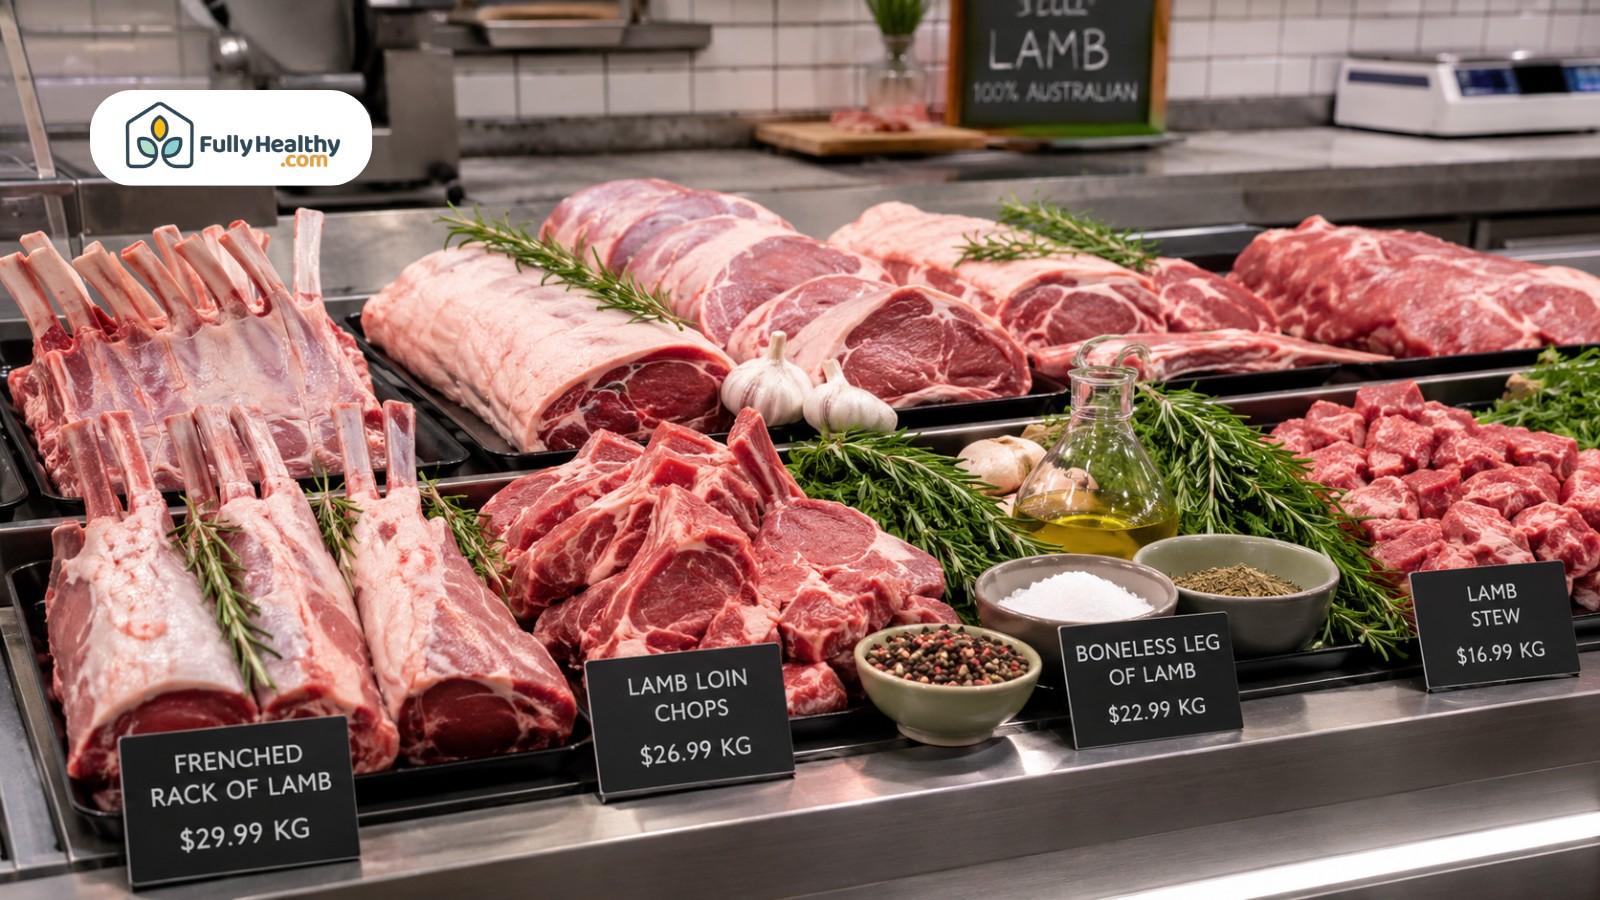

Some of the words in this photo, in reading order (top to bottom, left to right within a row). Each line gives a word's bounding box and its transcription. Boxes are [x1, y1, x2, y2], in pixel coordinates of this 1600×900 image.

[989, 28, 1109, 71] LAMB
[973, 82, 1018, 103] 100%
[1028, 81, 1138, 101] AUSTRALIAN
[1467, 583, 1517, 601] LAMB
[1472, 608, 1519, 627] STEW
[1076, 638, 1176, 662] BONELESS
[1184, 634, 1220, 652] LEG
[1457, 644, 1512, 666] $16.99
[1520, 641, 1545, 658] KG
[628, 674, 687, 695] LAMB
[696, 668, 747, 690] LOIN
[1109, 668, 1135, 685] OF
[1143, 663, 1196, 682] LAMB
[655, 699, 728, 722] CHOPS
[1109, 701, 1170, 725] $22.99
[1179, 697, 1205, 715] KG
[175, 745, 303, 774] FRENCHED
[641, 740, 711, 767] $26.99
[721, 736, 751, 756] KG
[151, 783, 217, 807] RACK
[227, 779, 258, 799] OF
[269, 772, 331, 795] LAMB
[181, 822, 262, 853] $29.99
[275, 818, 309, 840] KG
